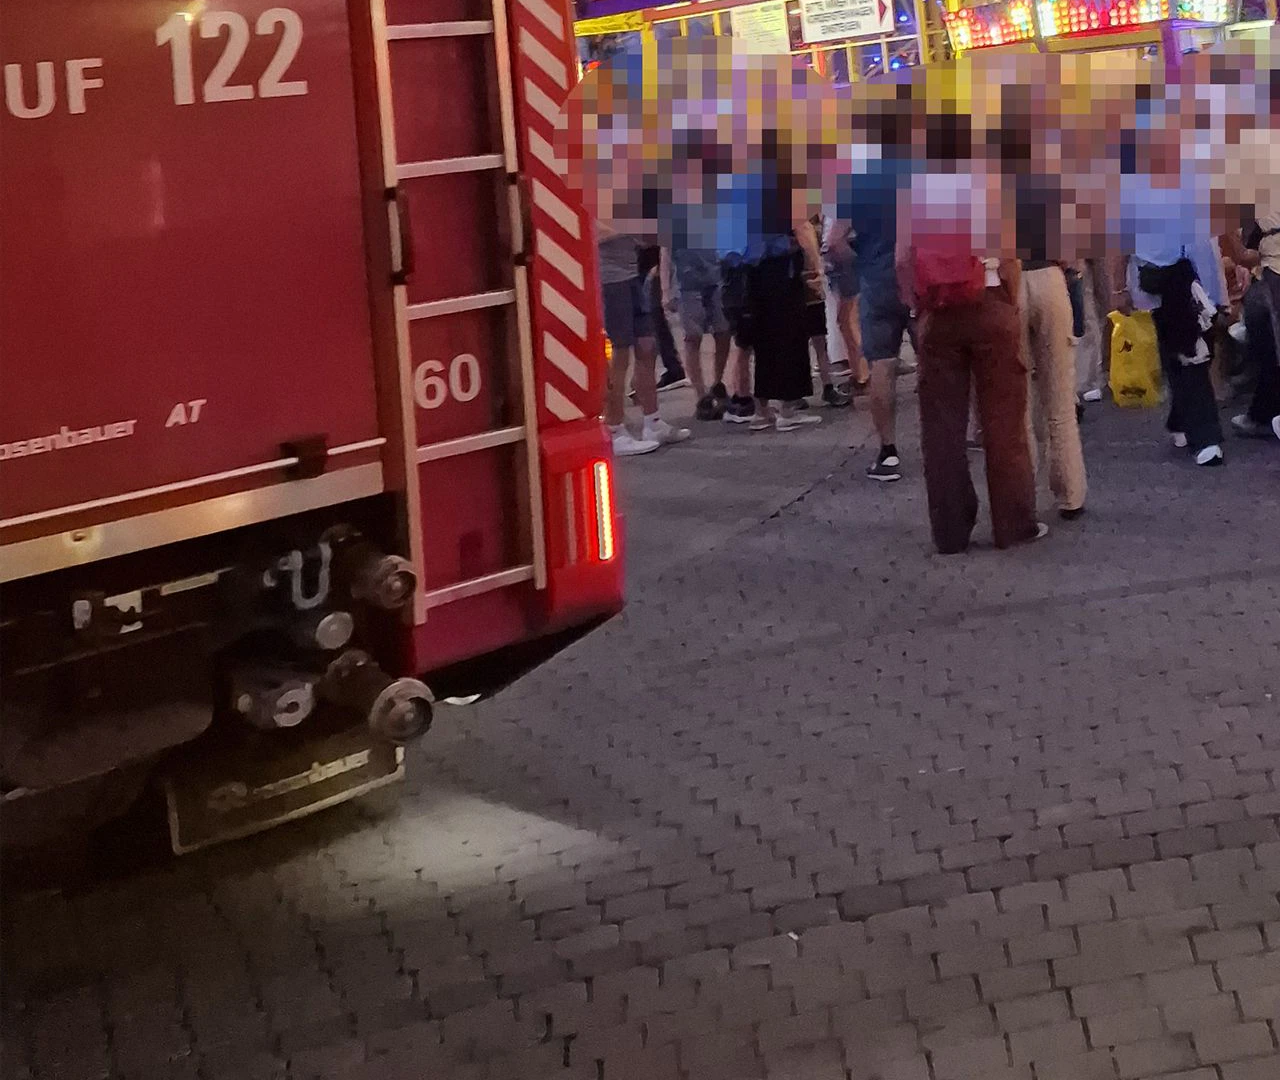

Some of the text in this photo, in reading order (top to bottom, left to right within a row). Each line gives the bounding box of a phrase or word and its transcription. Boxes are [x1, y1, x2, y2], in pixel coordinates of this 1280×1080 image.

[4, 7, 308, 119] UF 122
[414, 353, 481, 409] 60
[165, 399, 207, 427] AT
